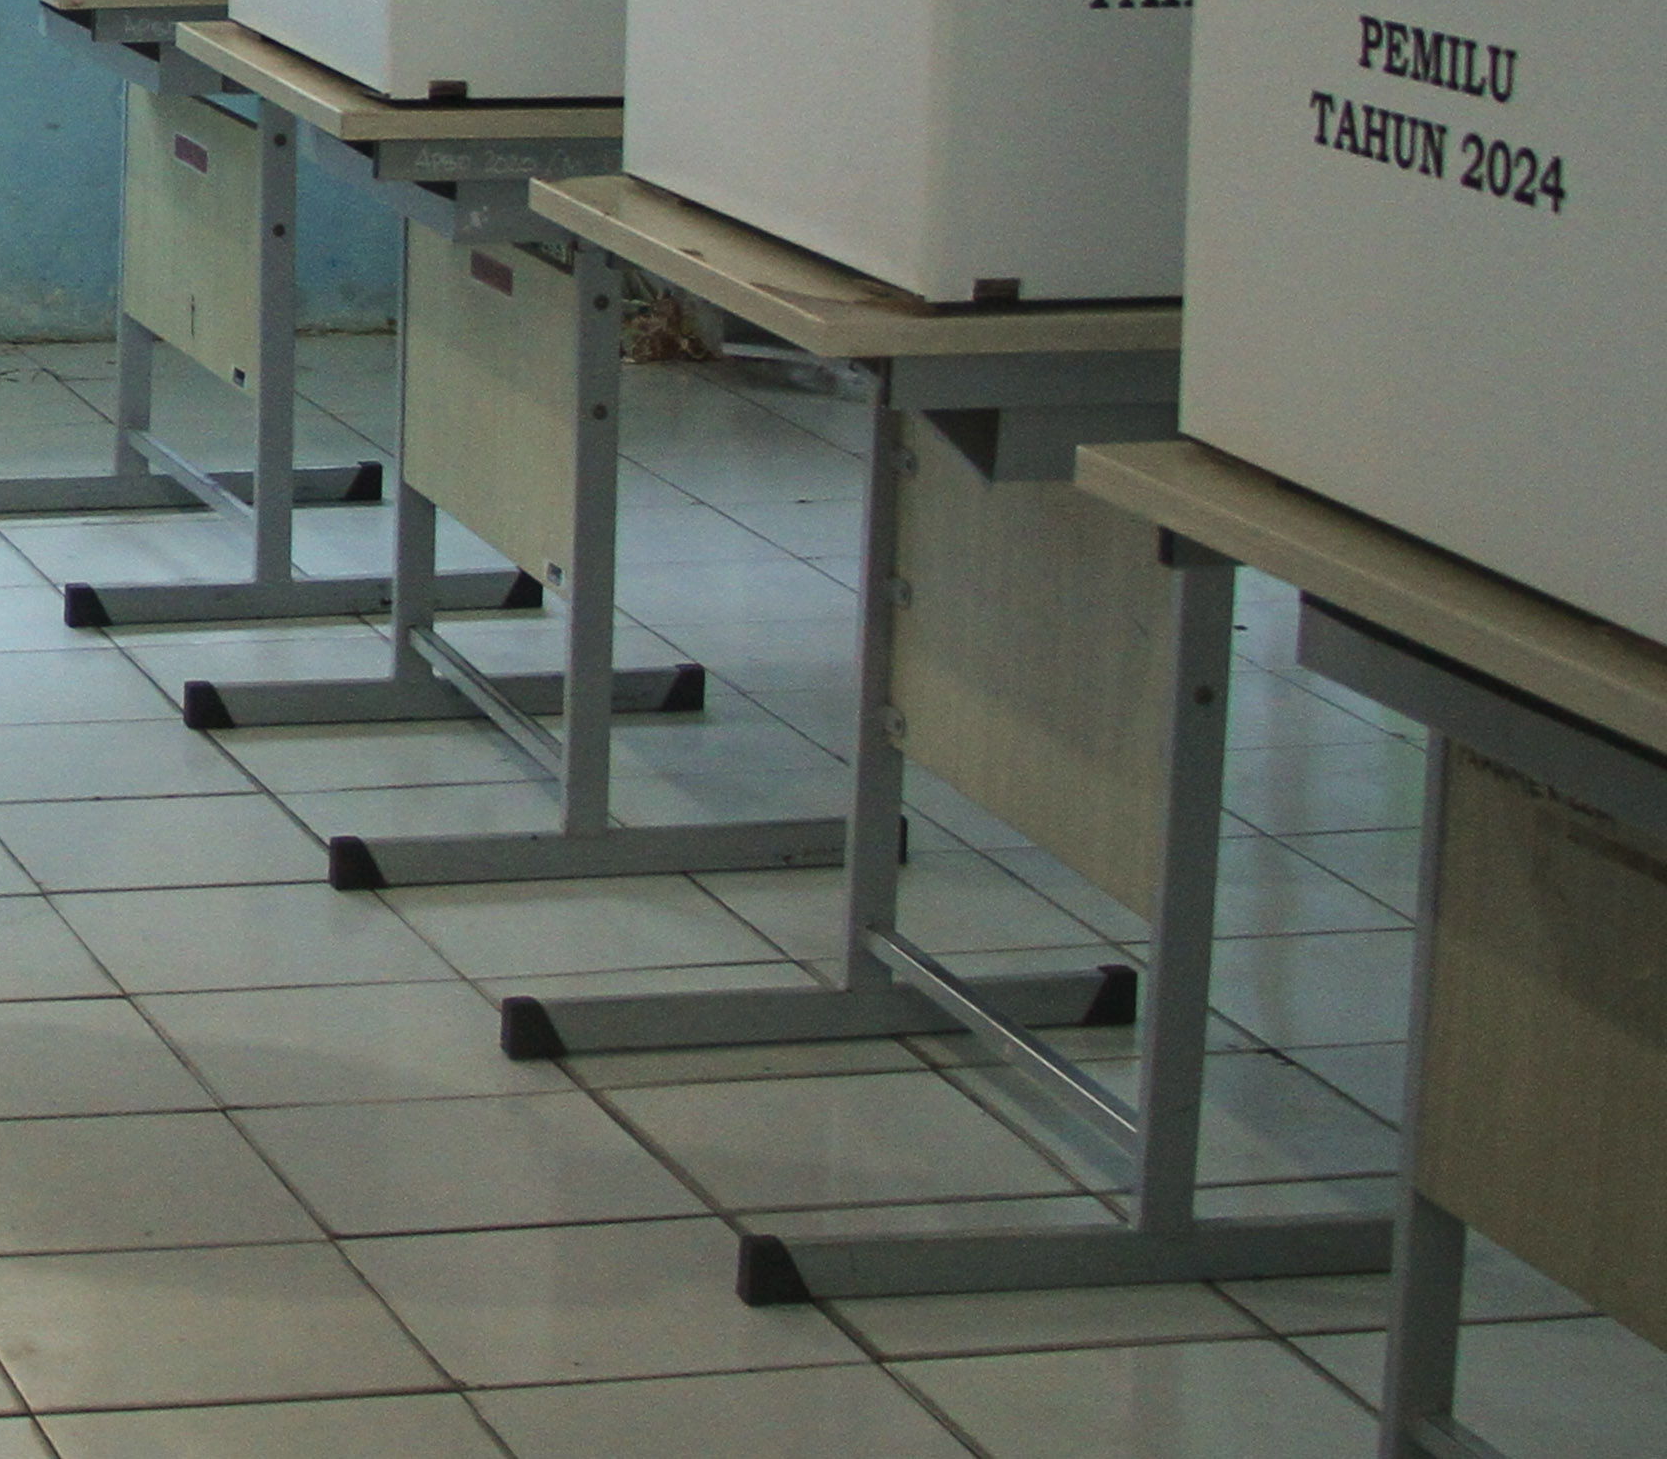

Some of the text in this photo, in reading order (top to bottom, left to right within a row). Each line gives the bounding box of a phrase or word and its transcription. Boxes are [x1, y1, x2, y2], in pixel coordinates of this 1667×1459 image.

[1358, 15, 1517, 103] PEMILU
[1309, 91, 1567, 214] TAHUN 2024
